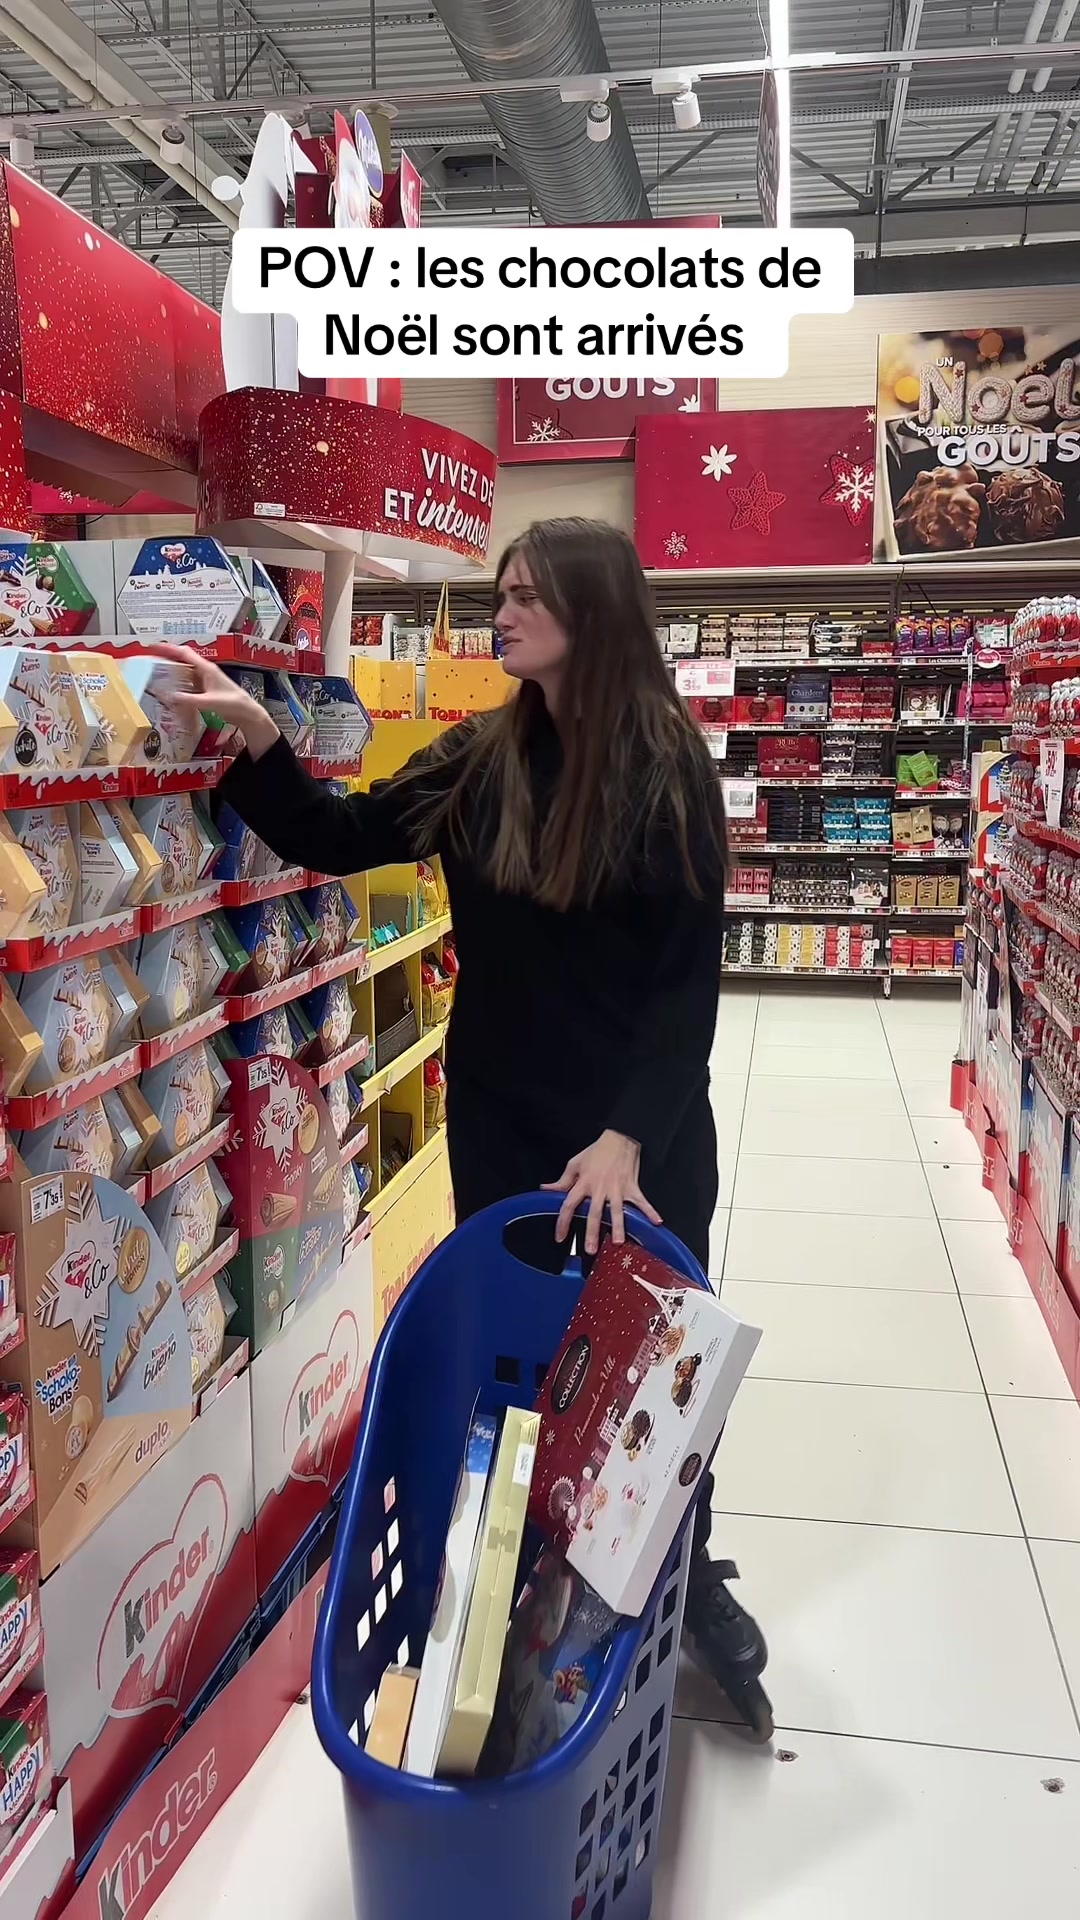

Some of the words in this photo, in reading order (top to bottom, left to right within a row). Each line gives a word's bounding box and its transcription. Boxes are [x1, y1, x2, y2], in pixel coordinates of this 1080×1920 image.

[936, 357, 954, 368] UN
[917, 426, 950, 436] POUR
[953, 425, 985, 436] TOUS
[987, 424, 1007, 434] LES
[936, 424, 1080, 467] GOÛTS
[421, 447, 478, 498] VIVEZ
[385, 487, 415, 521] ET
[6, 592, 27, 600] Kinder
[20, 600, 43, 618] &Co
[21, 661, 41, 674] bueno
[36, 714, 51, 722] Kinder
[46, 725, 62, 746] &Co
[281, 1111, 296, 1135] &Co
[67, 1252, 91, 1273] Kinder
[84, 1258, 109, 1299] &Co
[143, 1341, 176, 1390] bueno
[151, 1341, 168, 1359] Kinder
[41, 1367, 81, 1401] Schoko-
[47, 1360, 67, 1379] Kinder
[559, 1345, 589, 1408] COLLECTION
[50, 1387, 72, 1413] Bons
[299, 1351, 349, 1436] Kinder
[135, 1421, 169, 1463] duplo
[124, 1526, 209, 1658] Kinder
[0, 1601, 17, 1627] inder
[0, 1602, 27, 1649] APPY
[3, 1745, 40, 1812] HAPPY
[8, 1747, 29, 1779] Kinder
[98, 1747, 216, 1920] Kinder
